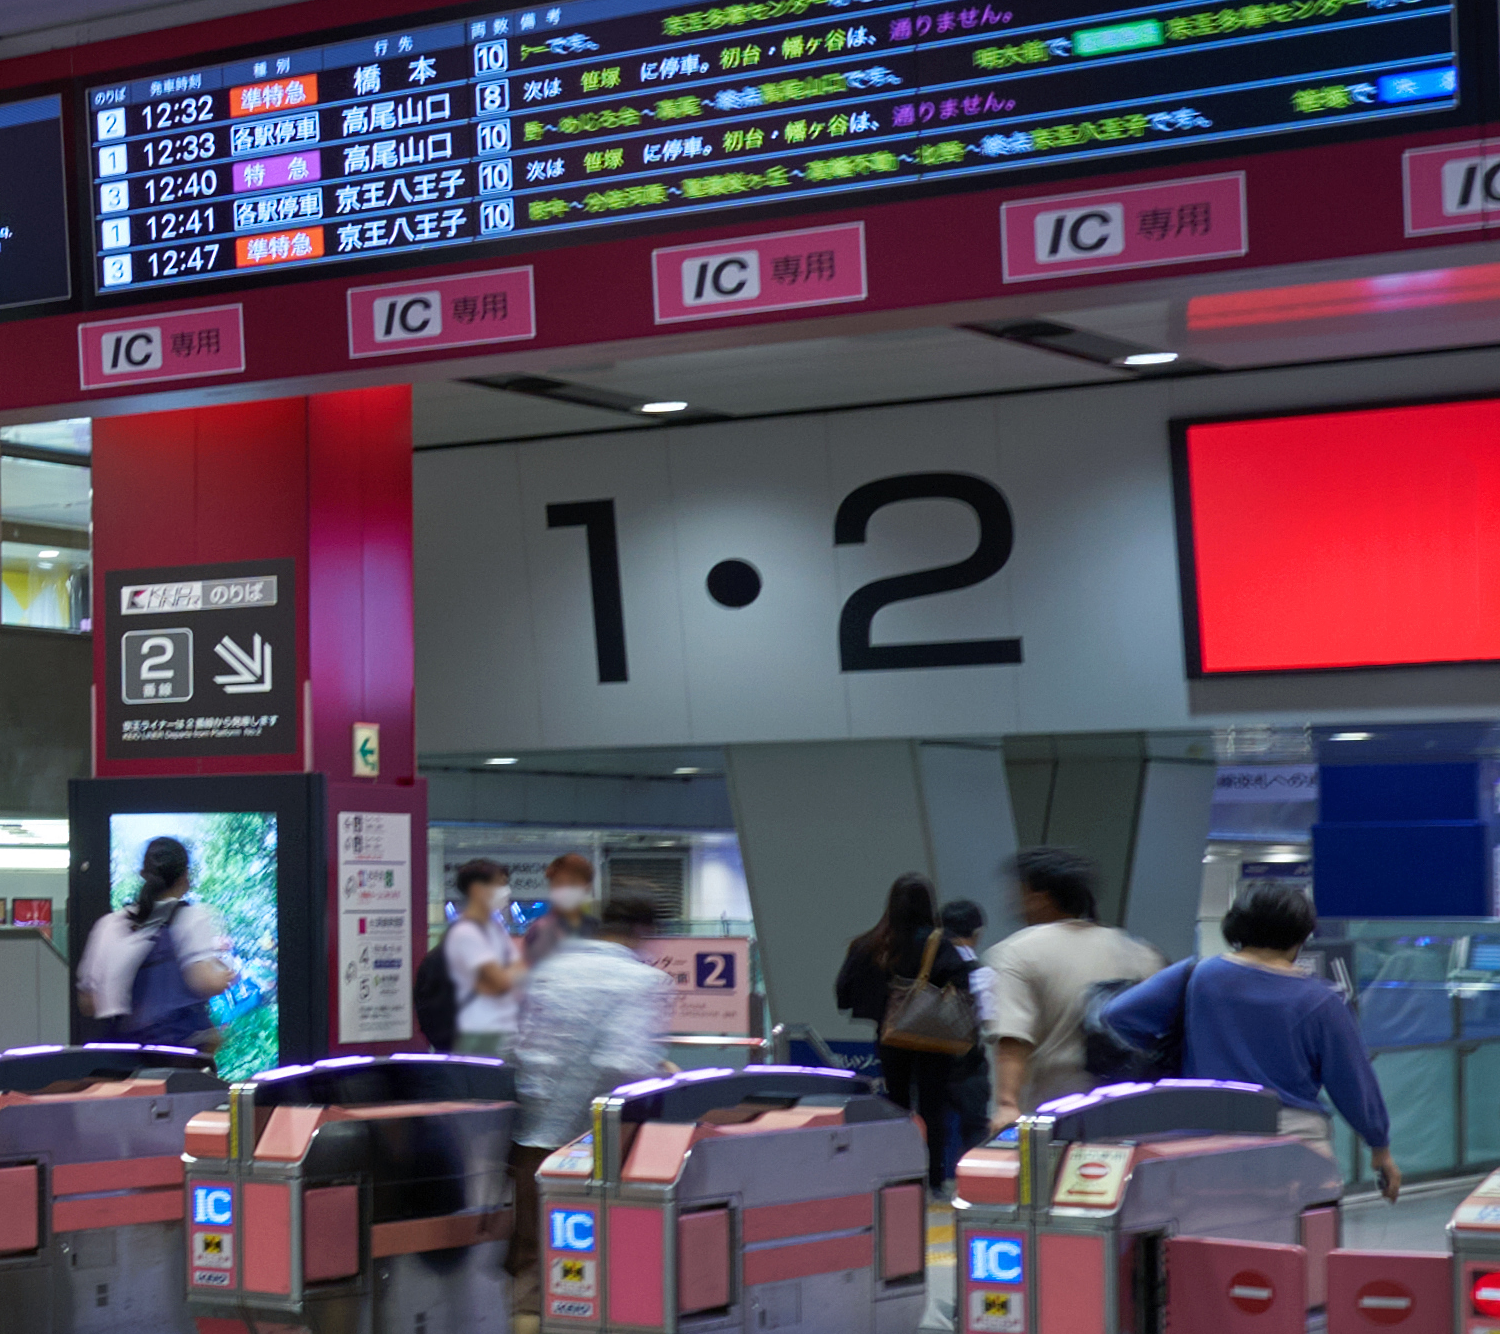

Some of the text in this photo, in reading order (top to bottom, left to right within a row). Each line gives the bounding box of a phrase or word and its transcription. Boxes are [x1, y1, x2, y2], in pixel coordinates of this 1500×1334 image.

[94, 86, 127, 105] のりば
[105, 45, 504, 135] 2 12:32 準特急 橋本 10
[143, 131, 216, 167] 12:33
[234, 116, 317, 152] 各駅停車
[341, 92, 451, 137] 高尾山口
[483, 83, 502, 111] 8
[522, 76, 563, 102] 次は
[144, 168, 218, 204] 12:40
[343, 132, 452, 176] 高尾山口
[482, 124, 508, 150] 10
[145, 206, 216, 241] 12:41
[236, 193, 319, 227] 各駅停車
[335, 168, 466, 215] 京王八王子
[483, 164, 509, 190] 10
[525, 157, 566, 183] 次は
[148, 243, 220, 278] 12:47
[246, 232, 313, 263] 準特急
[337, 208, 468, 253] 京王八王子
[484, 204, 511, 229] 10
[1046, 201, 1213, 256] IC 専用
[692, 249, 837, 299] IC 専用
[381, 291, 508, 337] IC 専用
[108, 329, 222, 368] IC 専用
[209, 580, 264, 605] のりば
[140, 636, 175, 680] 2
[703, 954, 729, 987] 2
[193, 1187, 232, 1225] IC
[551, 1211, 594, 1251] IC
[971, 1238, 1022, 1281] IC
